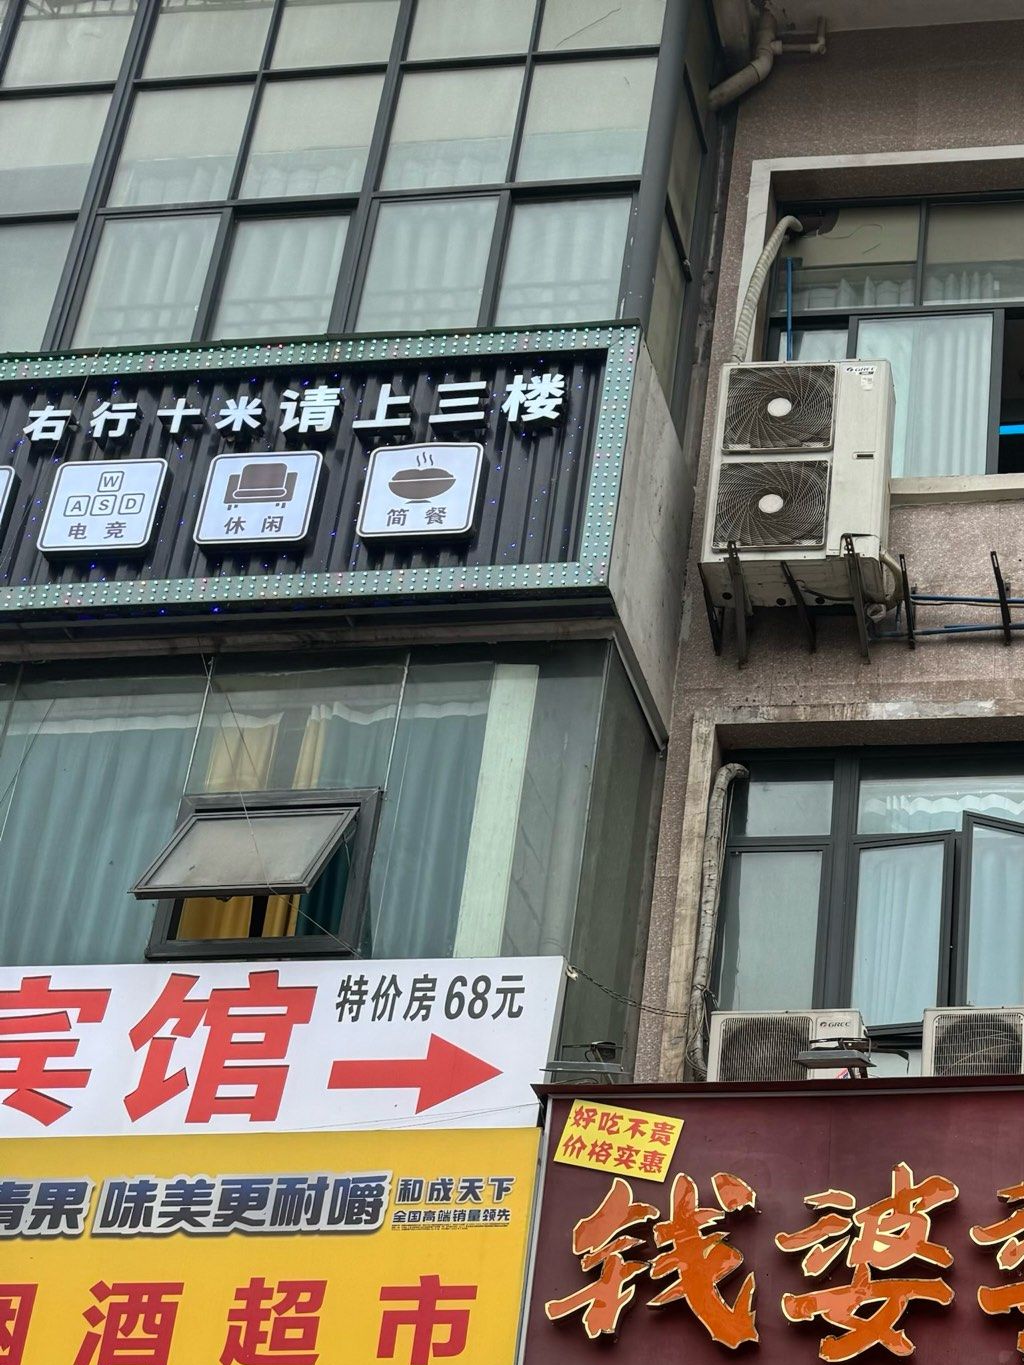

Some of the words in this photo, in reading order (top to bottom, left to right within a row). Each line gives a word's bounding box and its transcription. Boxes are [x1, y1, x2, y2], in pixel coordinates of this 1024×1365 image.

[23, 372, 566, 441] 右行十米请上三楼
[103, 474, 120, 489] W
[68, 520, 127, 540] 电竞
[224, 514, 284, 536] 休闲
[387, 506, 448, 528] 简餐
[335, 974, 525, 1024] 特价房68元
[0, 970, 318, 1127] 宾馆
[571, 1103, 675, 1147] 好吃不贵
[561, 1135, 665, 1176] 价格实惠
[397, 1177, 515, 1203] 和成天下
[393, 1208, 510, 1225] 全国高端销量领先
